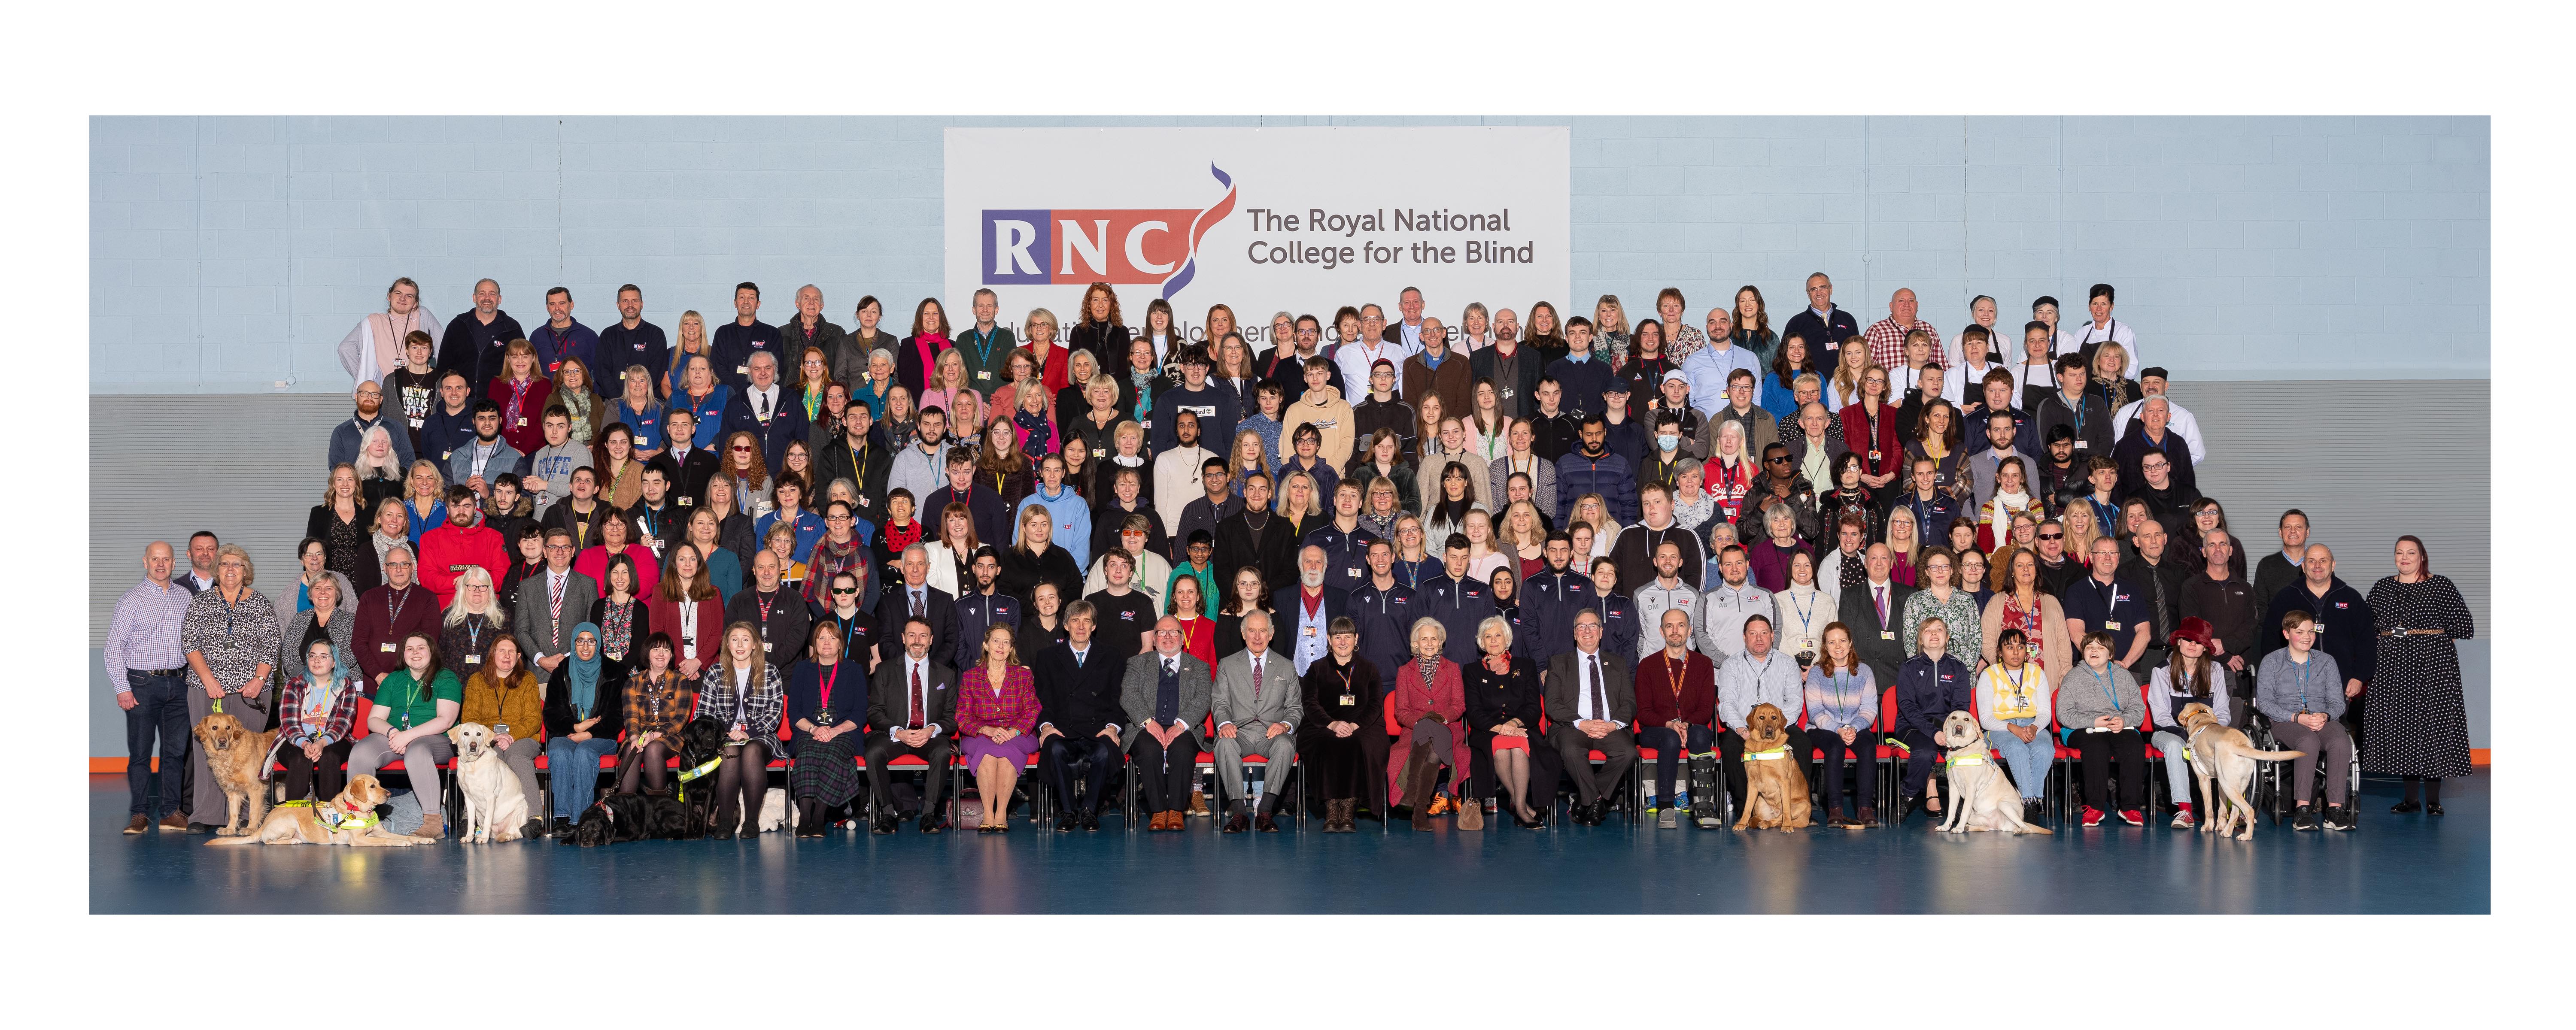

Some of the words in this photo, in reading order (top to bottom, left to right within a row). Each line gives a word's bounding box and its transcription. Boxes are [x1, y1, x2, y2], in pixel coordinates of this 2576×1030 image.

[1247, 209, 1299, 231] The
[1310, 209, 1385, 238] Royal
[1395, 209, 1510, 231] National
[993, 219, 1176, 276] RNC
[1248, 241, 1354, 270] College
[1364, 241, 1403, 264] for
[1411, 241, 1455, 264] the
[1467, 241, 1533, 264] Blind
[402, 387, 430, 399] NEW
[403, 396, 429, 408] YORK
